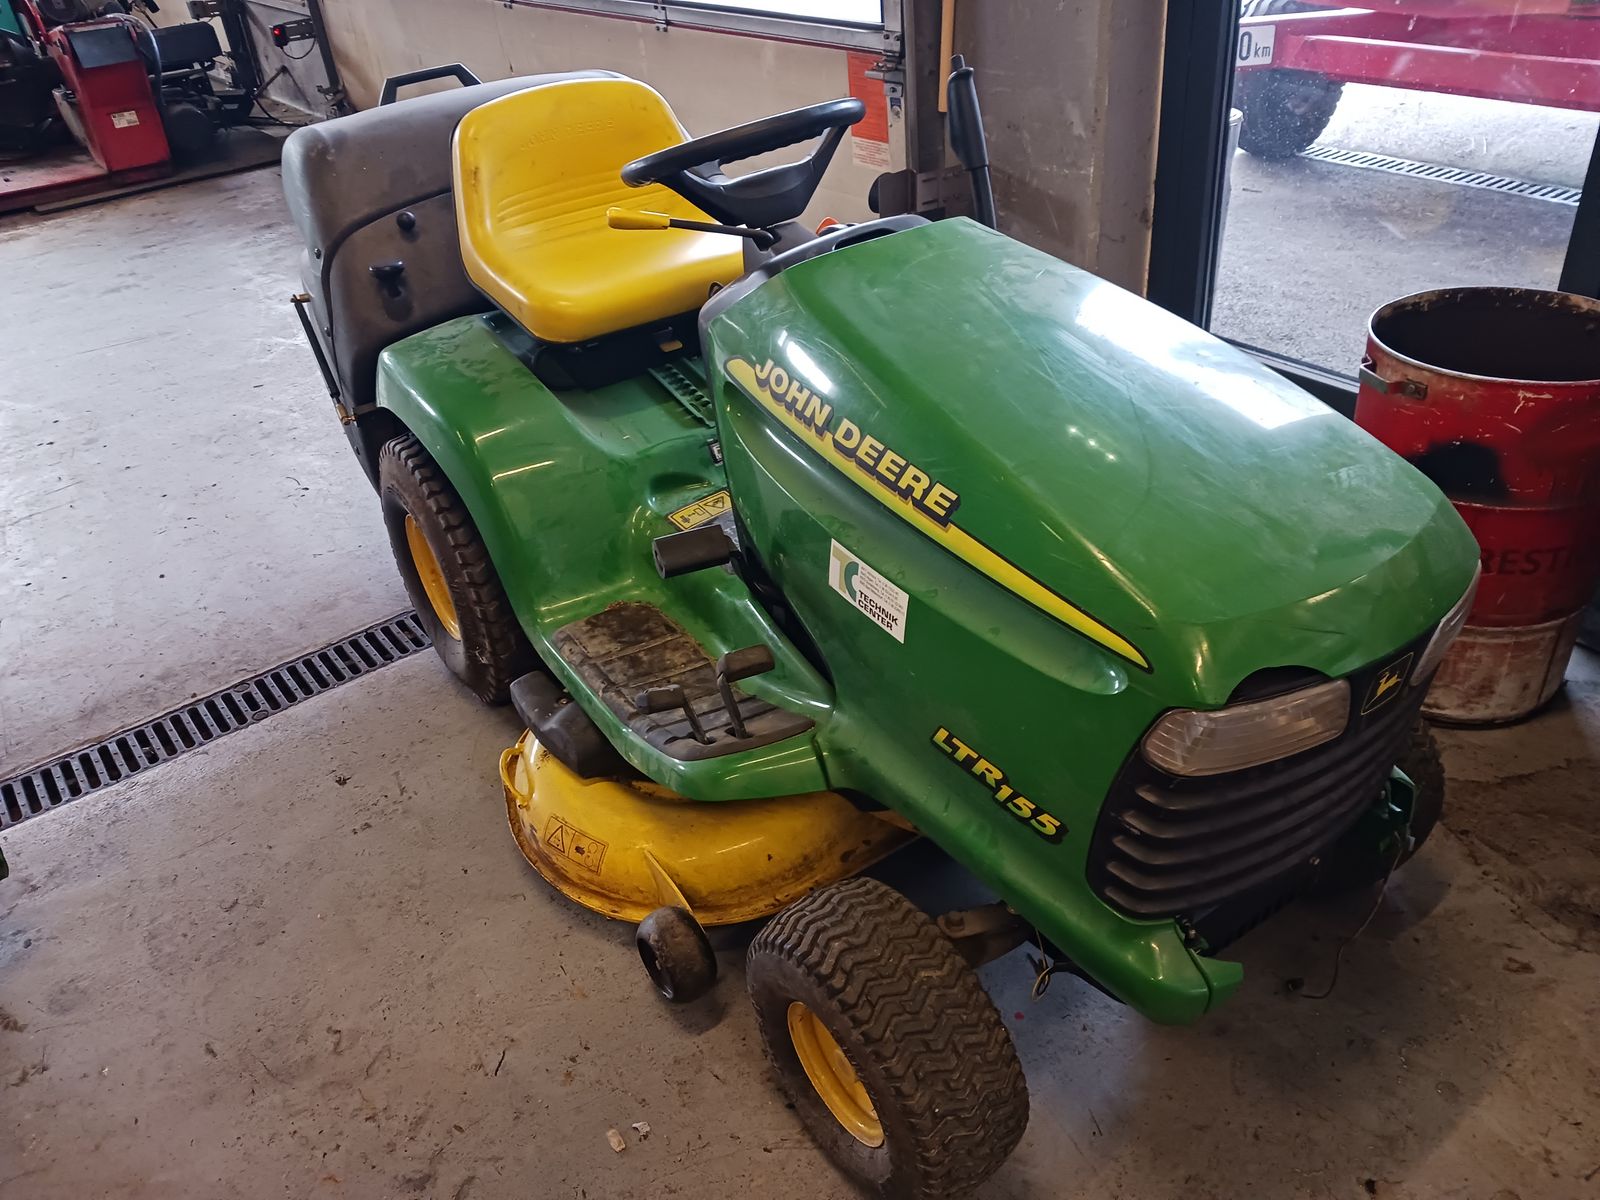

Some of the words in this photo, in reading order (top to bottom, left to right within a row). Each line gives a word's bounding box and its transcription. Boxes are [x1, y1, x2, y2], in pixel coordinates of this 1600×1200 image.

[1254, 43, 1271, 58] km
[754, 358, 833, 434] JOHN
[833, 418, 960, 522] DEERE
[1481, 546, 1573, 576] REST
[858, 590, 899, 626] TECHNIK
[858, 599, 893, 631] CENTER
[932, 727, 1062, 837] LTR155
